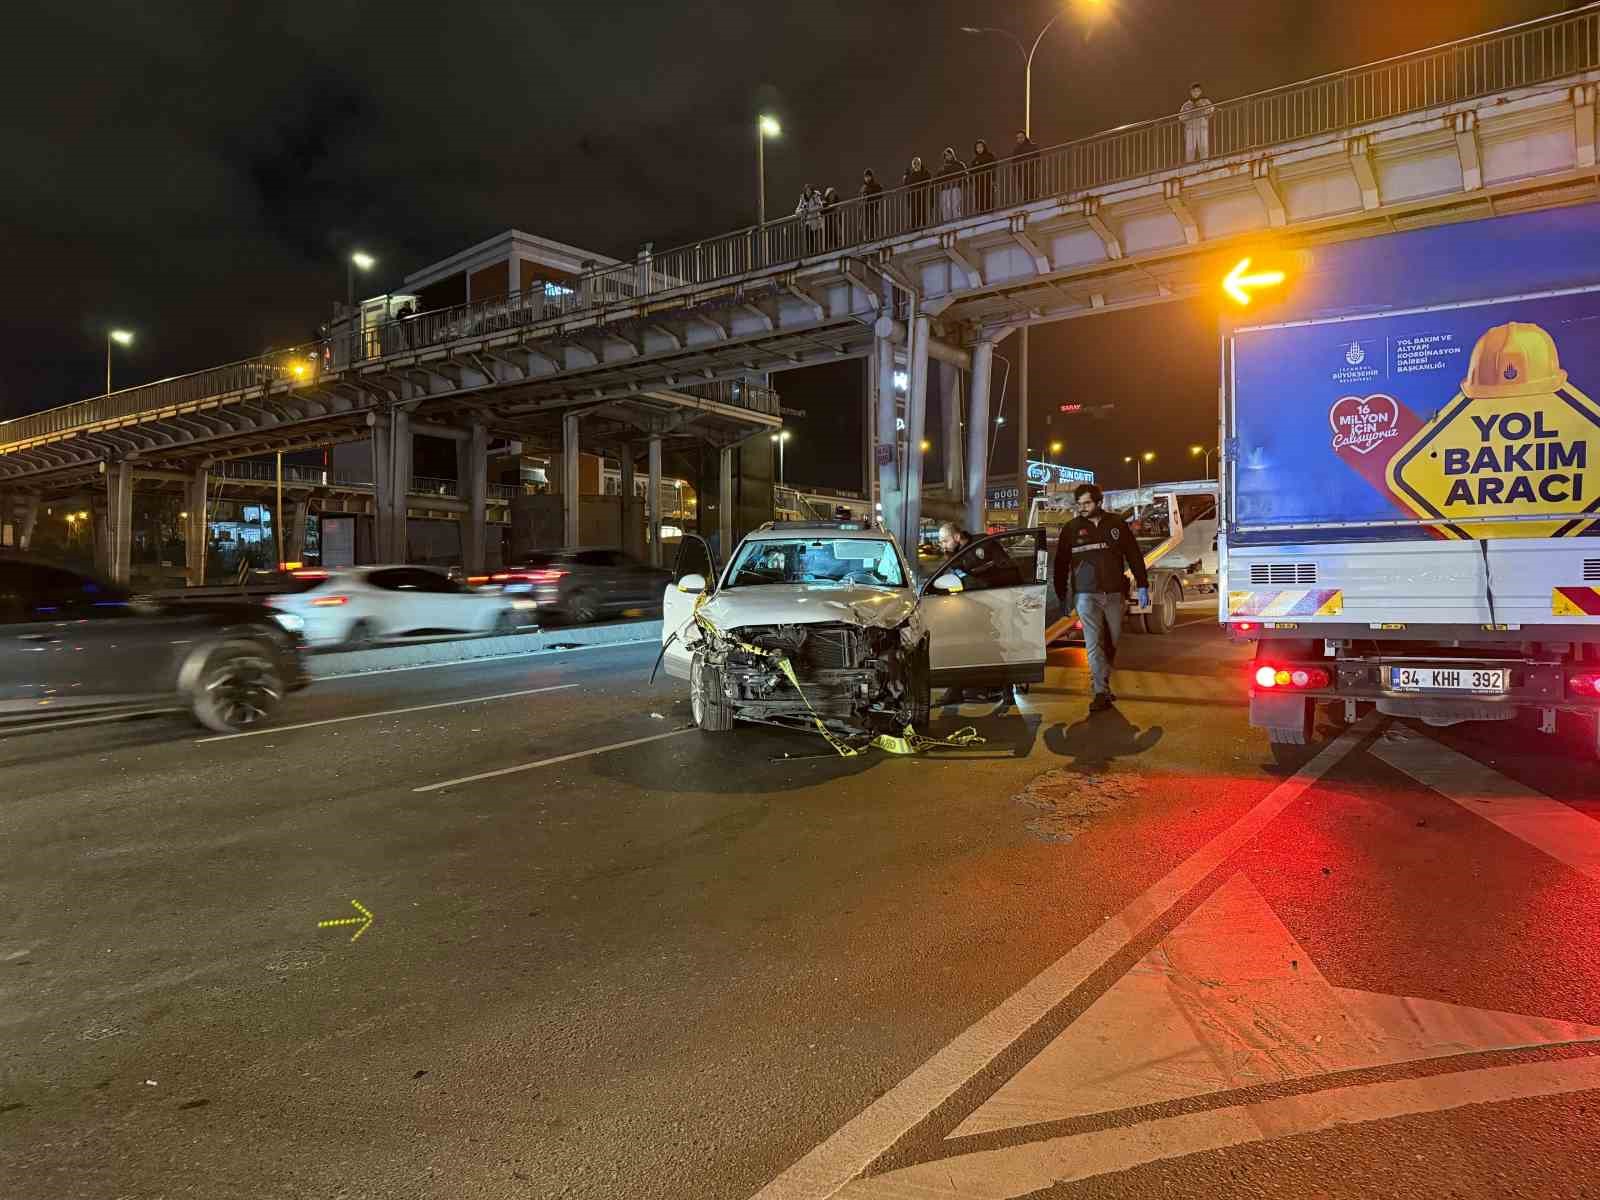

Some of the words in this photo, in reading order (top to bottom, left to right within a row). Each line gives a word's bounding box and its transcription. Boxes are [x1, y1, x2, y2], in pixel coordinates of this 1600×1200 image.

[1356, 404, 1370, 415] 16
[1471, 411, 1559, 442] YOL
[1444, 441, 1587, 475] BAKIM
[1444, 473, 1583, 506] ARACI
[1402, 670, 1419, 685] 34
[1432, 671, 1460, 686] KHH
[1472, 672, 1501, 688] 392
